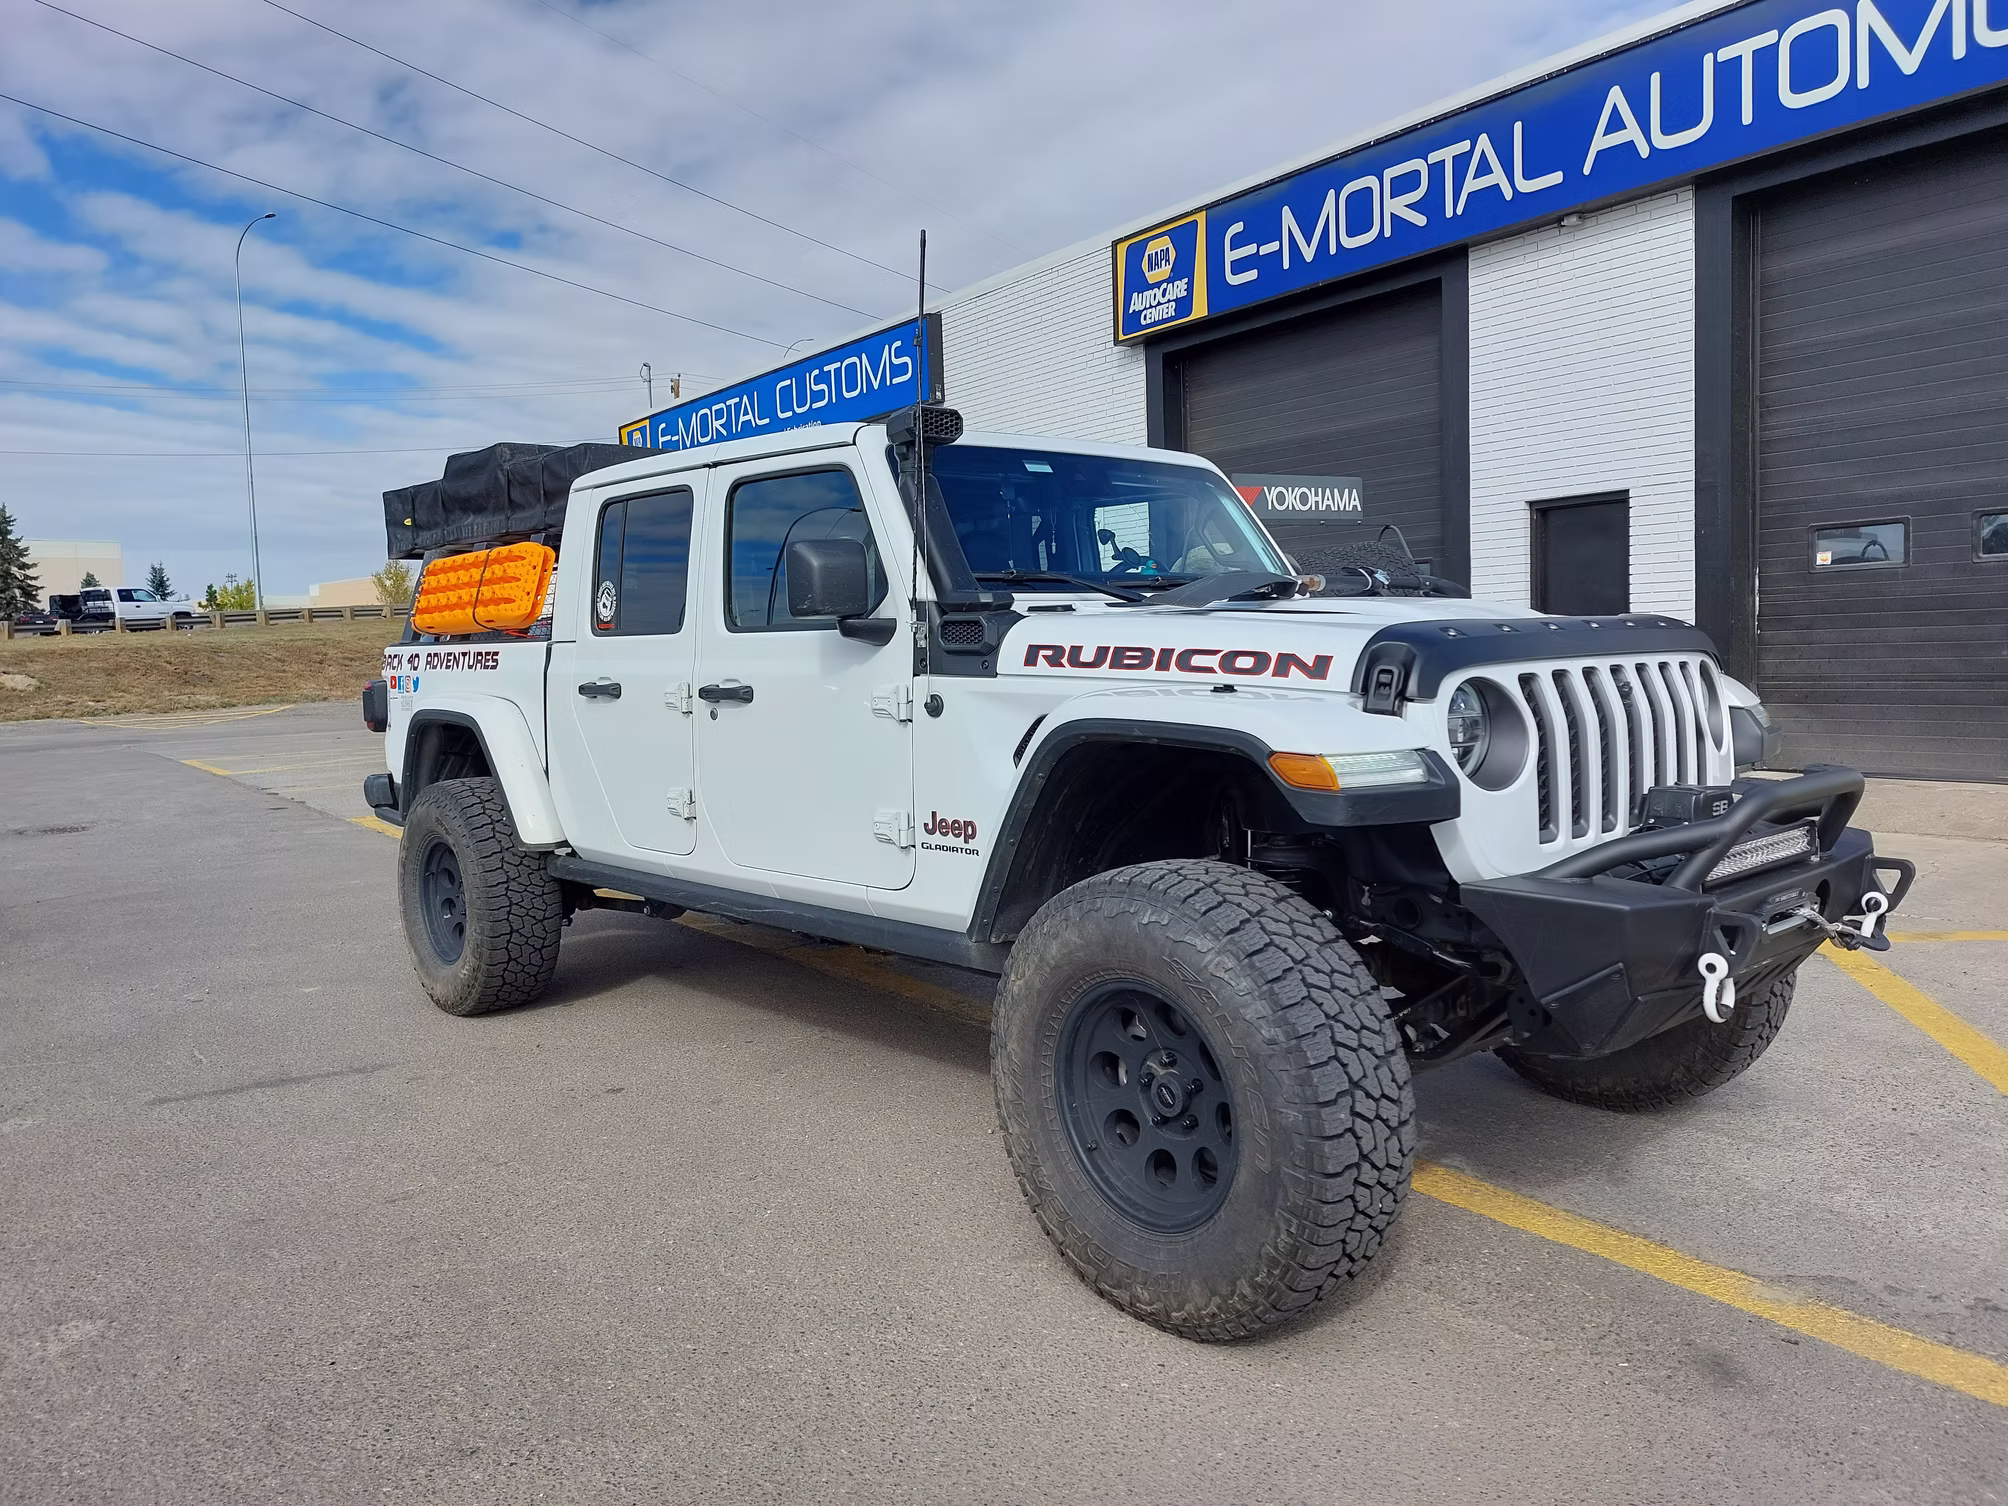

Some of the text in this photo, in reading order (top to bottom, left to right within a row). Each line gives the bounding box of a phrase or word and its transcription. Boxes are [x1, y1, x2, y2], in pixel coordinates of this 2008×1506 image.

[1224, 0, 2008, 286] E-MORTAL AUTOM
[1147, 246, 1171, 273] NAPA
[1140, 301, 1176, 325] CENTER
[776, 340, 912, 419] CUSTOMS
[787, 420, 822, 431] rication
[1264, 486, 1362, 512] YOKOHAMA
[407, 653, 421, 671] 40
[424, 650, 500, 672] ADVENTURES
[1024, 643, 1334, 681] RUBICON
[923, 811, 977, 844] Jeep
[920, 842, 980, 857] GLADIATOR
